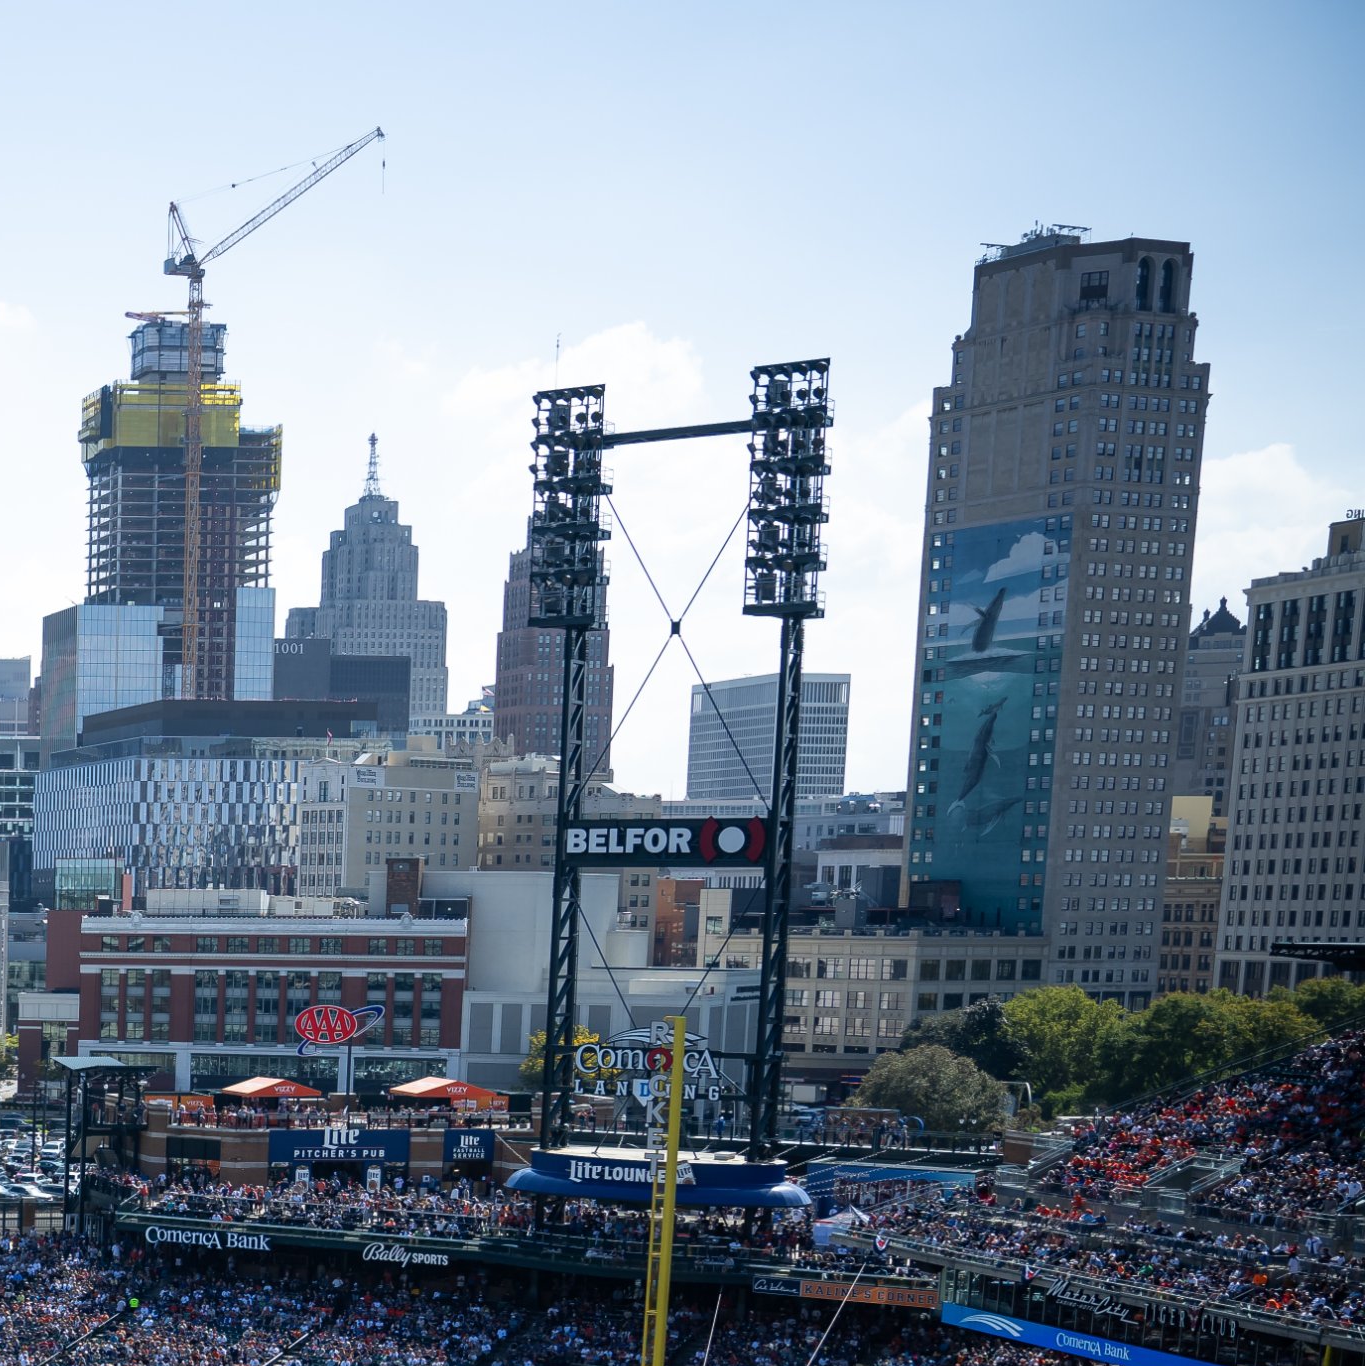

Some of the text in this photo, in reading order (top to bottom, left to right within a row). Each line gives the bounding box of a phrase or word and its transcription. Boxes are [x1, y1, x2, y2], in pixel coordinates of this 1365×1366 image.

[567, 828, 693, 854] BELFOR
[273, 1086, 296, 1094] VIZZY
[445, 1086, 468, 1095] VIZZY
[645, 1021, 673, 1177] ROCKET
[321, 1126, 360, 1149] Lite
[459, 1134, 480, 1148] Lite
[293, 1149, 386, 1159] PITCHER'S PUB
[569, 1160, 602, 1183] Lite
[227, 1232, 270, 1251] Bank
[363, 1242, 449, 1268] Bally SPORTS
[805, 1283, 872, 1300] KALINE'S
[877, 1290, 935, 1305] CORNER
[1047, 1277, 1141, 1326] MotorCity
[1144, 1303, 1237, 1339] TIGER CLUB
[1104, 1343, 1131, 1361] Bank
